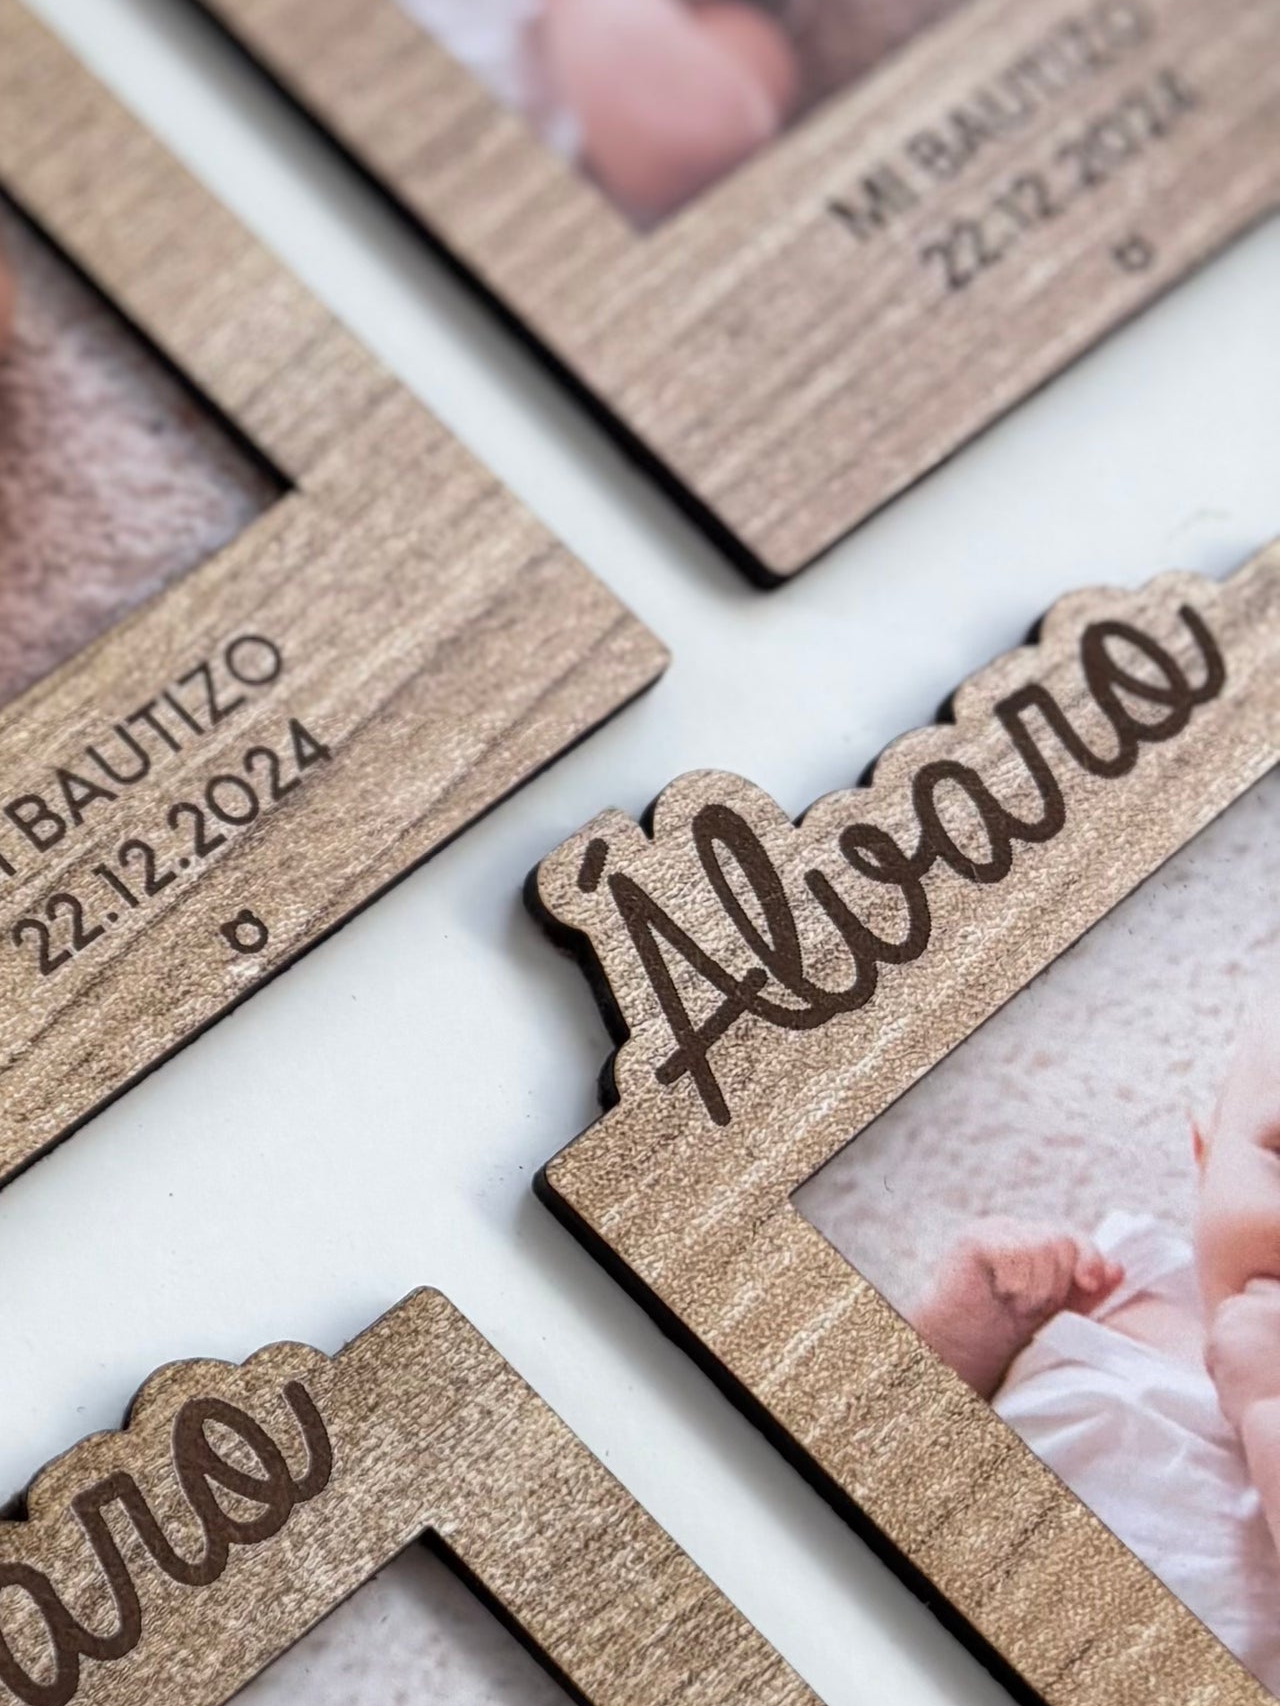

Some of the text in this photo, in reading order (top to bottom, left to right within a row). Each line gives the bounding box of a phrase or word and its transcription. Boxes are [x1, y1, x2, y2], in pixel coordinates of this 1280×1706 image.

[3, 633, 283, 854] BAUTIZO
[11, 717, 333, 977] 22.12.2024
[577, 603, 1226, 1126] Álvaro
